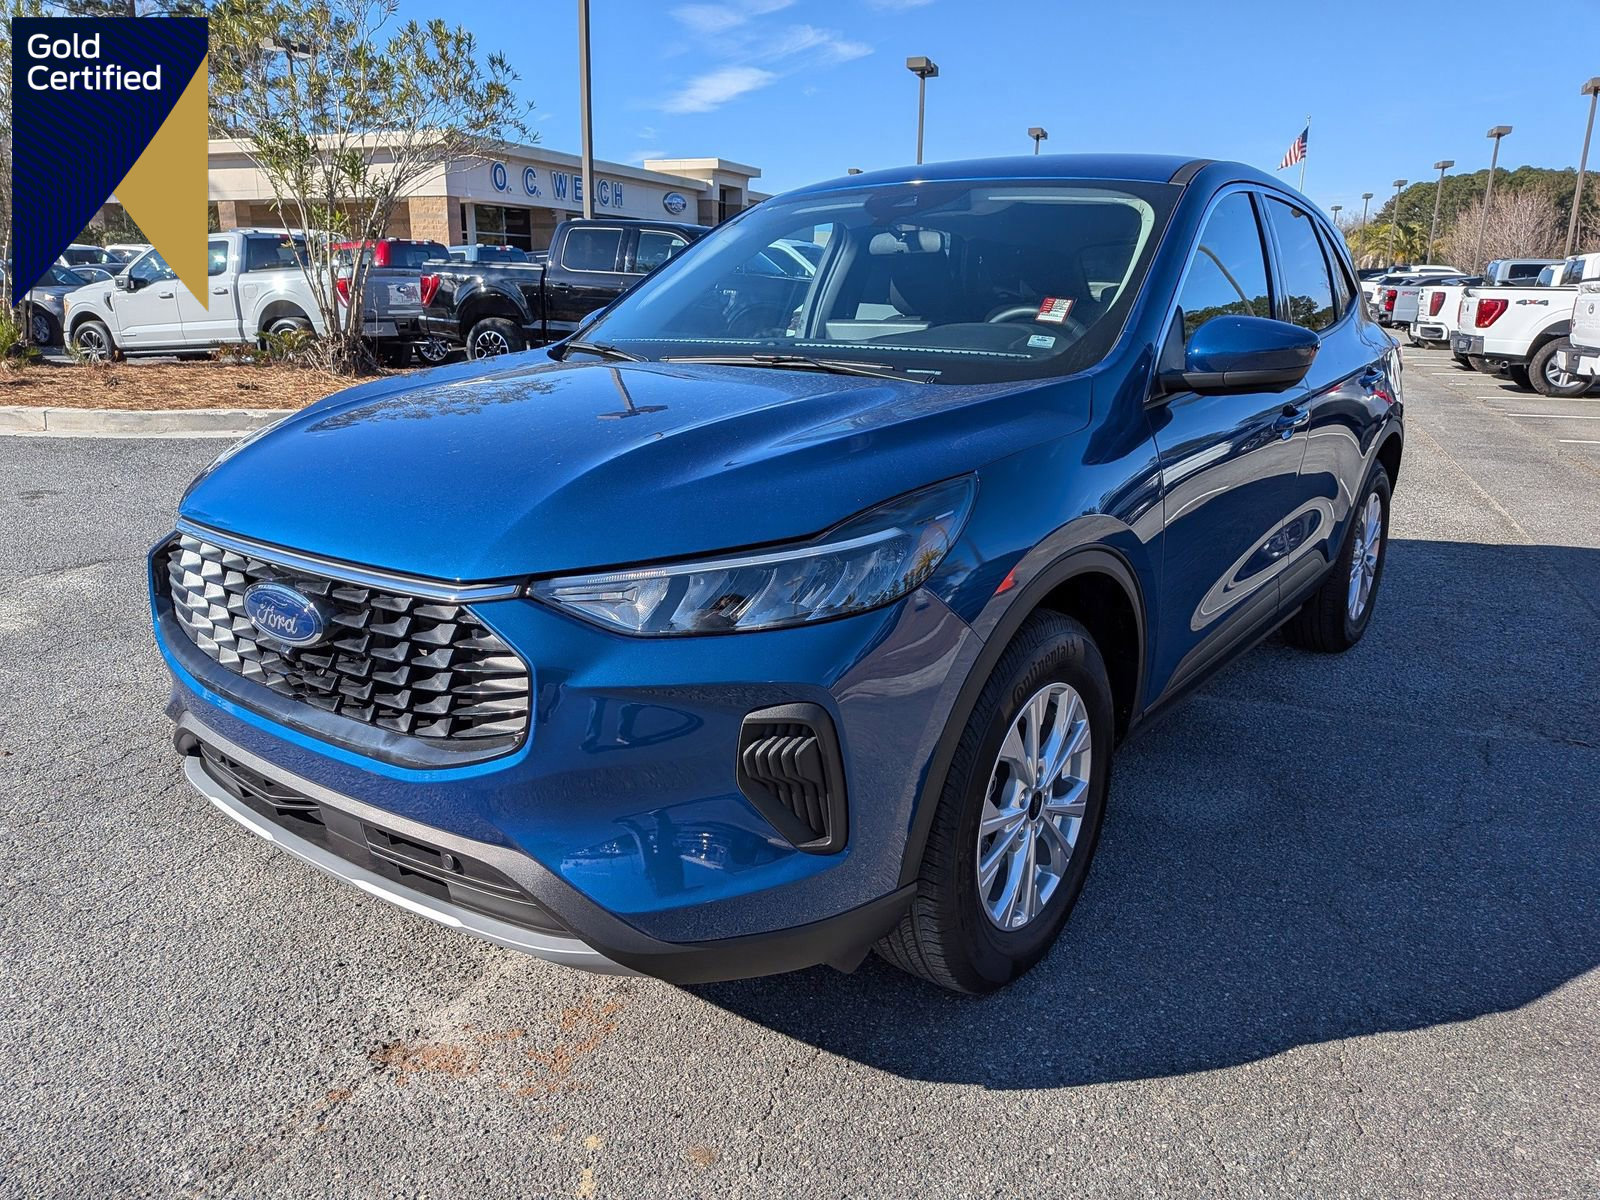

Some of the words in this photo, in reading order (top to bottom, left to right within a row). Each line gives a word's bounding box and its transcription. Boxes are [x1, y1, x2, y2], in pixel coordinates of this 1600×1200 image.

[491, 161, 513, 193] O.
[523, 166, 542, 197] C.
[551, 170, 624, 208] WECH
[256, 595, 299, 635] Ford
